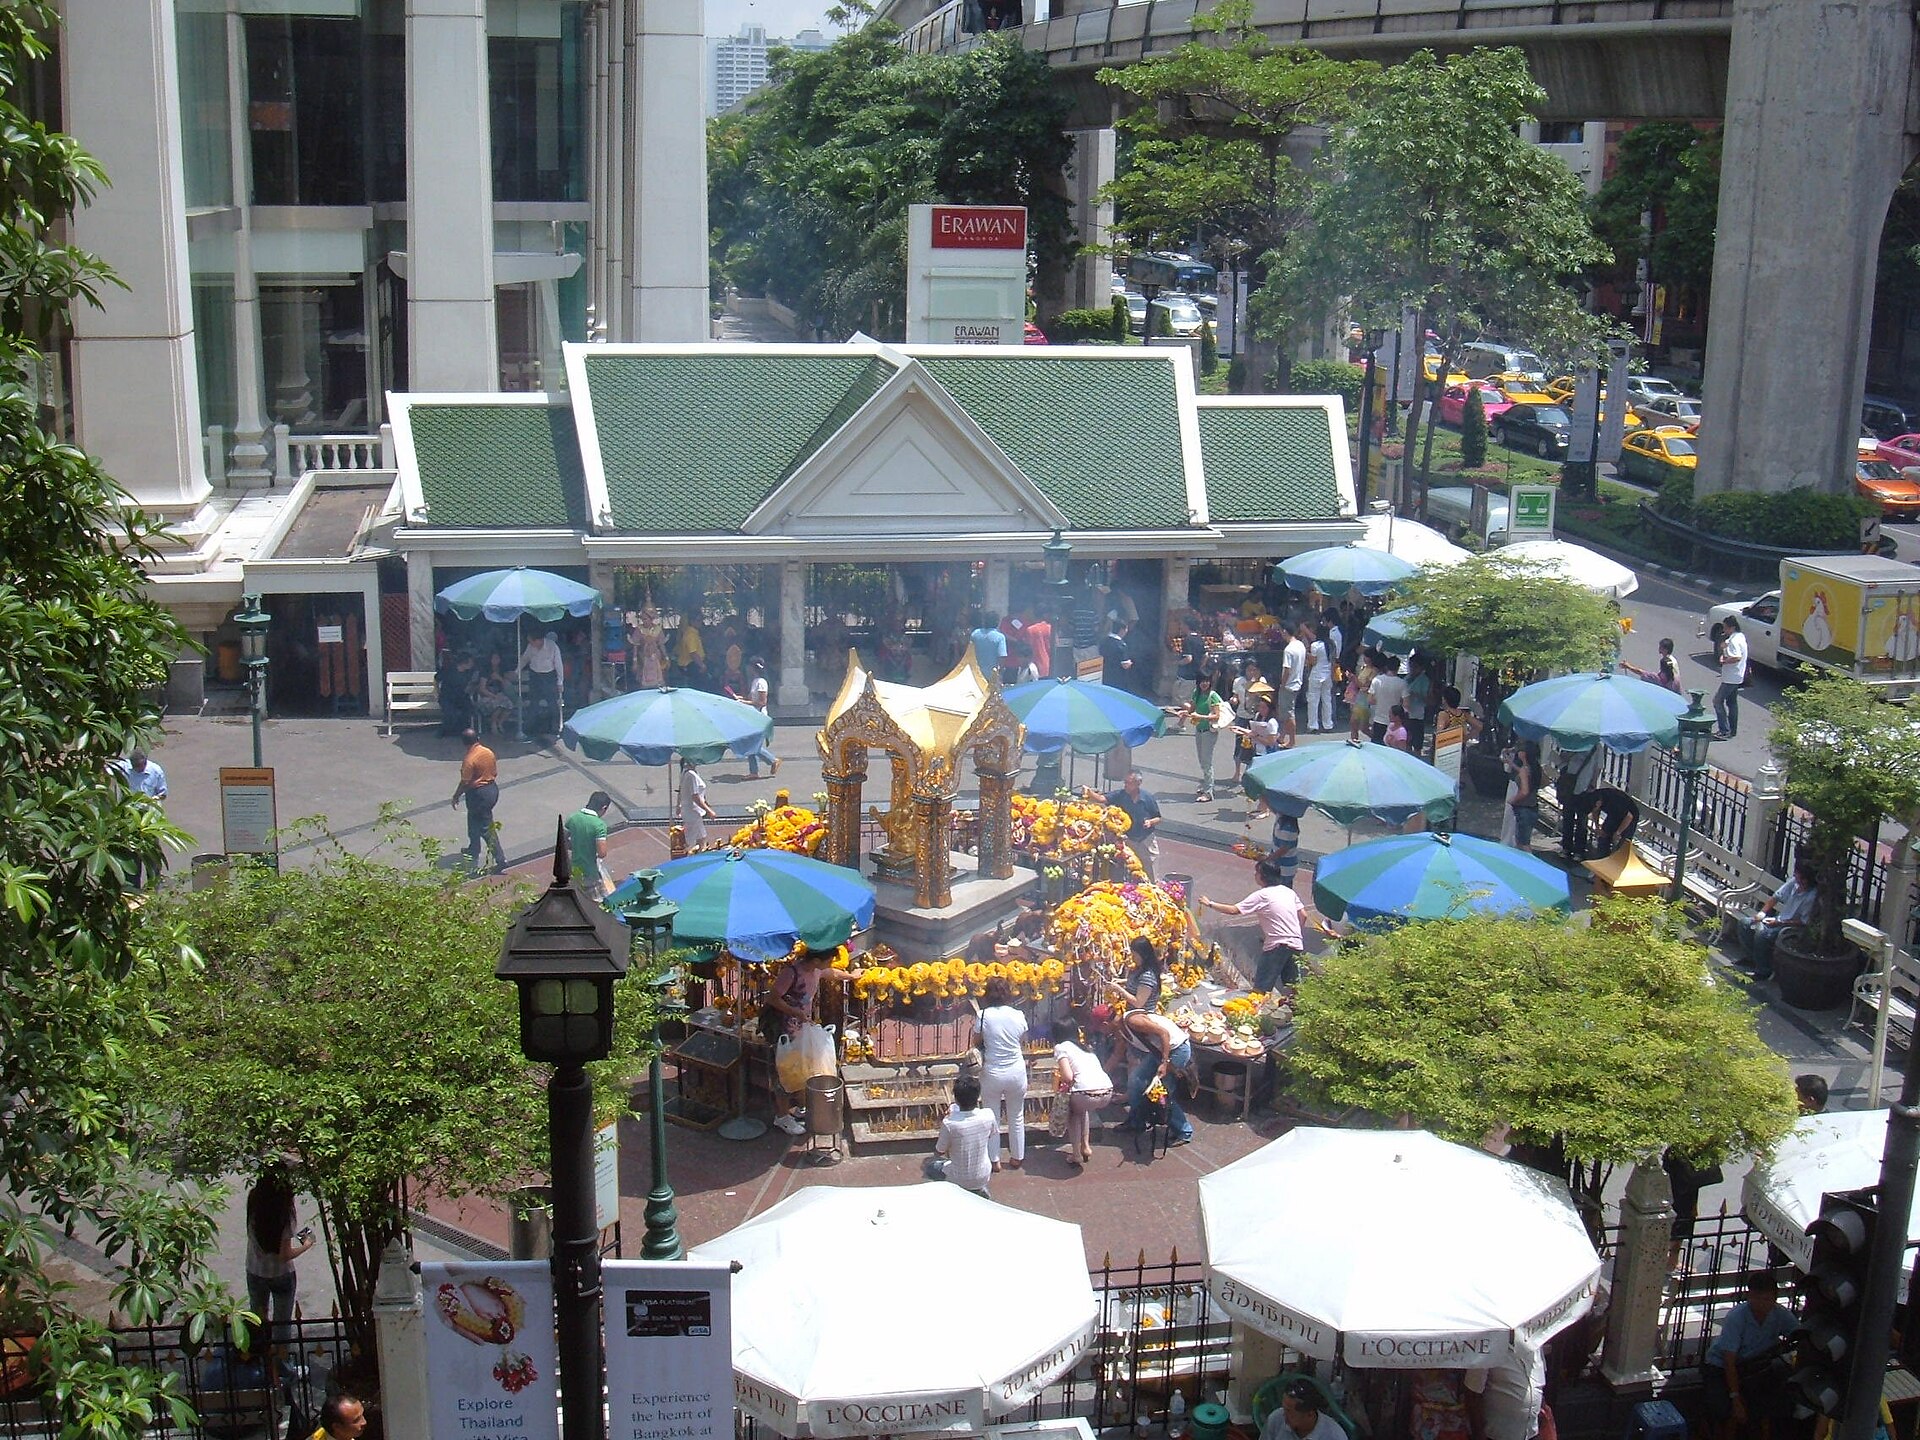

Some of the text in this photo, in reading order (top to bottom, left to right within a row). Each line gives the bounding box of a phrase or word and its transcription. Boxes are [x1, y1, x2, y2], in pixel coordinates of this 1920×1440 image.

[941, 215, 1017, 235] ERAWAN
[954, 325, 1000, 336] ERAWAN
[1360, 1337, 1491, 1357] L'OCCITANE
[457, 1397, 514, 1412] Explore
[632, 1391, 711, 1406] Experience
[631, 1407, 712, 1422] the heart of
[827, 1400, 966, 1425] L'OCCITANE
[459, 1414, 523, 1429] Thailand
[633, 1425, 712, 1440] Bangkok at
